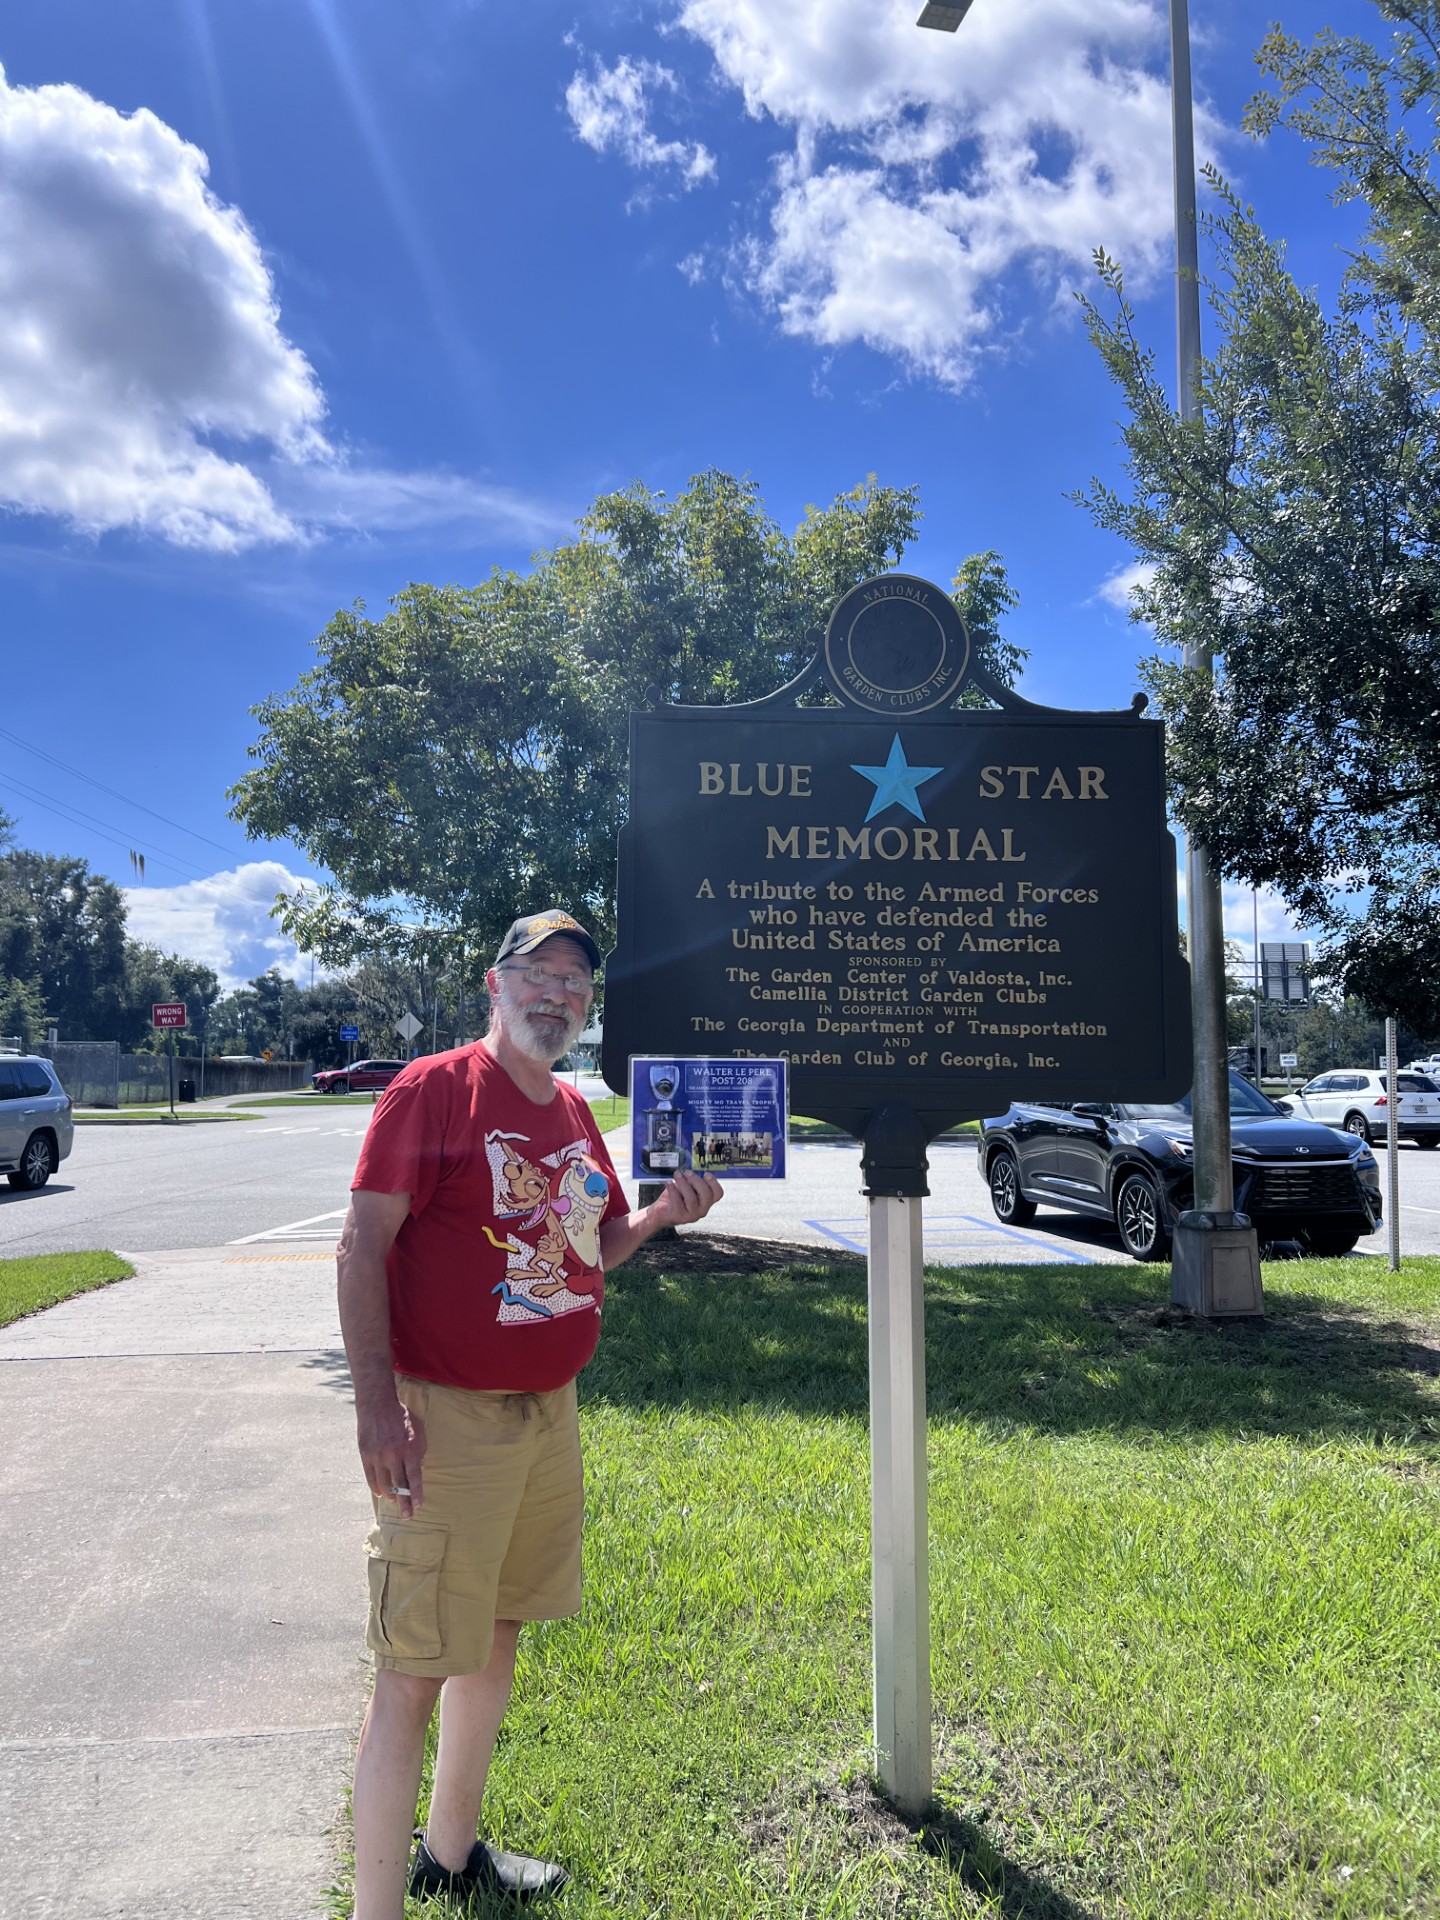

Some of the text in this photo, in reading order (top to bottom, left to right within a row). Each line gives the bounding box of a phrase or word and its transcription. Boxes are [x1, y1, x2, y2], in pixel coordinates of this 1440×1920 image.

[863, 584, 929, 605] NATIONAL
[842, 666, 953, 706] GARDEN CLUBS INC.
[699, 762, 1109, 799] BLUE STAR
[766, 826, 1026, 861] MEMORIAL
[696, 879, 1098, 903] A tribute to the Armed Forces
[749, 905, 1047, 927] who have defended the
[732, 929, 1060, 952] United States of America
[849, 957, 946, 966] SPONSORED BY
[726, 968, 1072, 986] The Garden Center of Valdosta, Inc.
[750, 986, 1046, 1003] Camellia District Garden Clubs
[156, 1007, 182, 1016] WRONG
[819, 1005, 976, 1015] IN COOPERATION WITH
[161, 1016, 177, 1025] WAY
[691, 1017, 1107, 1038] The Georgia Department of Transportation
[883, 1038, 910, 1047] AND
[778, 1050, 842, 1066] Garden
[855, 1051, 895, 1065] Club
[909, 1052, 928, 1065] of
[941, 1052, 1017, 1070] Georgia,
[1028, 1053, 1059, 1067] Inc.
[693, 1068, 772, 1076] WALTER LE PERE
[711, 1076, 753, 1085] POST 208
